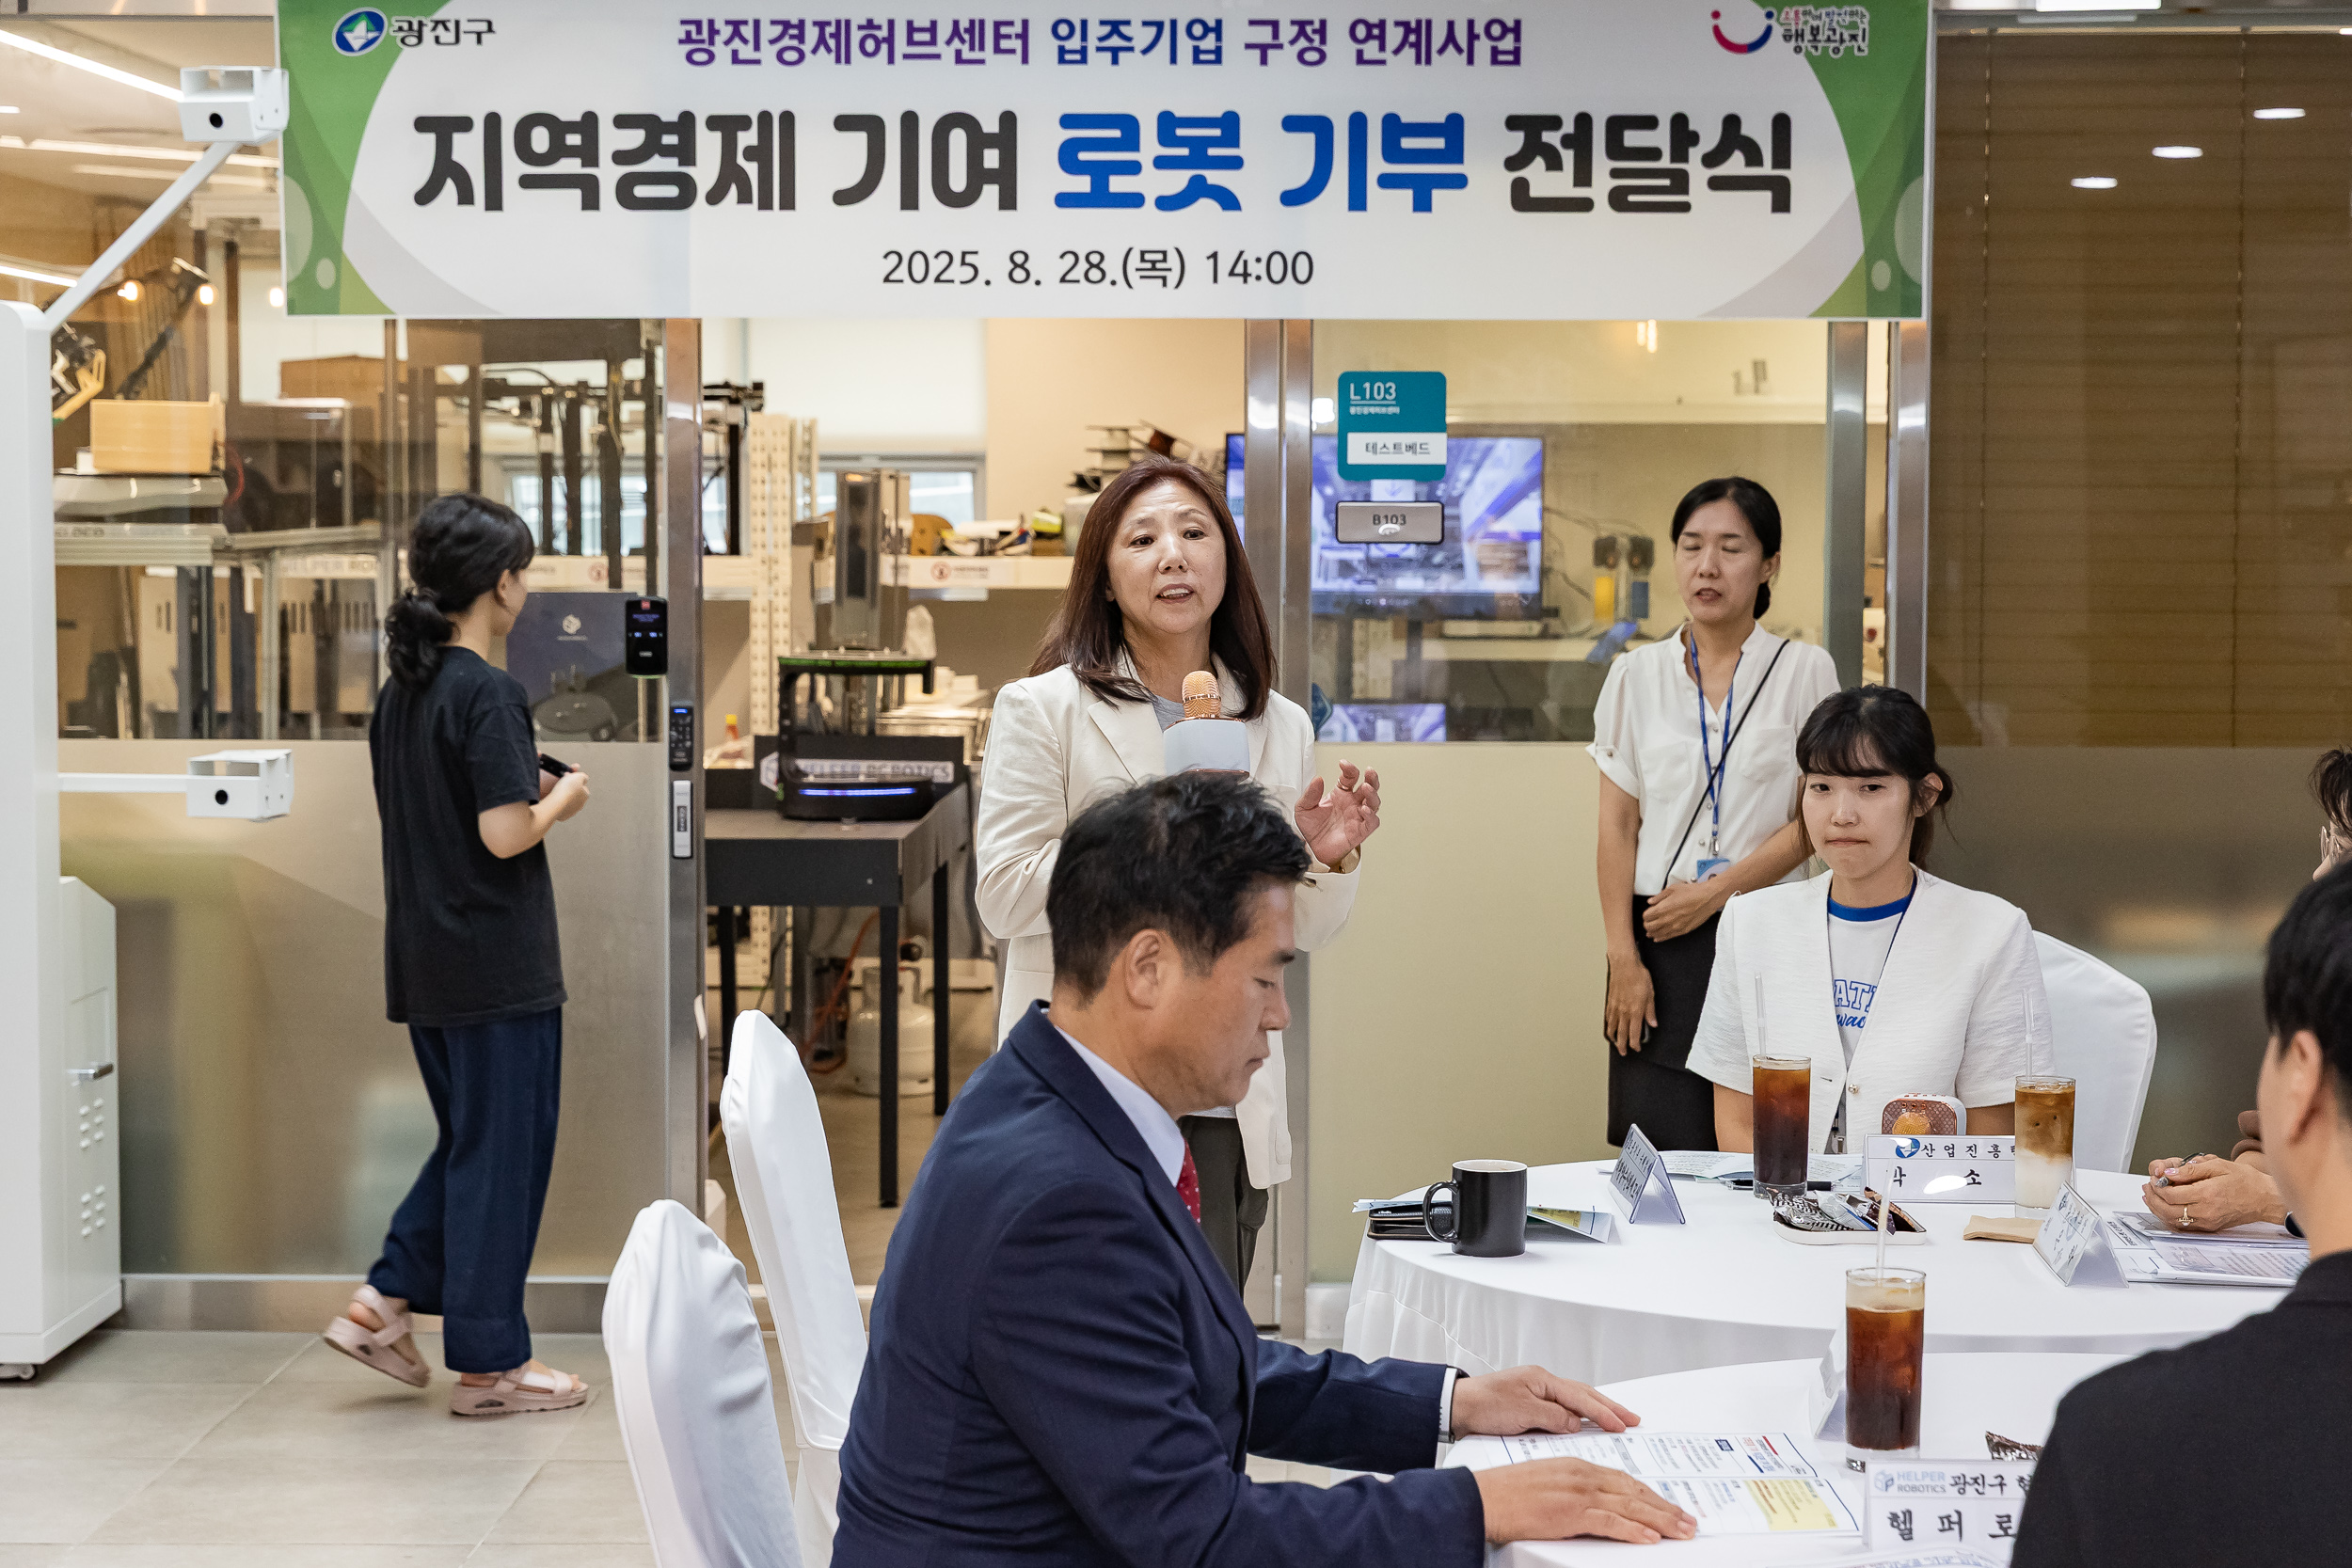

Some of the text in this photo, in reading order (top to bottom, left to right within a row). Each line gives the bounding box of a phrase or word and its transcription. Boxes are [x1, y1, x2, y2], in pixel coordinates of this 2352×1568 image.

[392, 18, 496, 47] 광진구
[677, 17, 1522, 67] 광진경제허브센터 입주기업 구정 연계사업
[1783, 25, 1867, 55] 행복광진
[413, 109, 1792, 214] 지역경제 기여 로봇 기부 전달식
[882, 246, 1314, 290] 2025. 8. 28.(목) 14:00
[1349, 381, 1397, 402] L103
[1365, 442, 1431, 456] 테스트베드
[1372, 514, 1407, 527] B103
[1897, 1470, 1947, 1482] HELPER
[1949, 1472, 2008, 1496] 광진구
[1897, 1483, 1947, 1494] ROBOTICS
